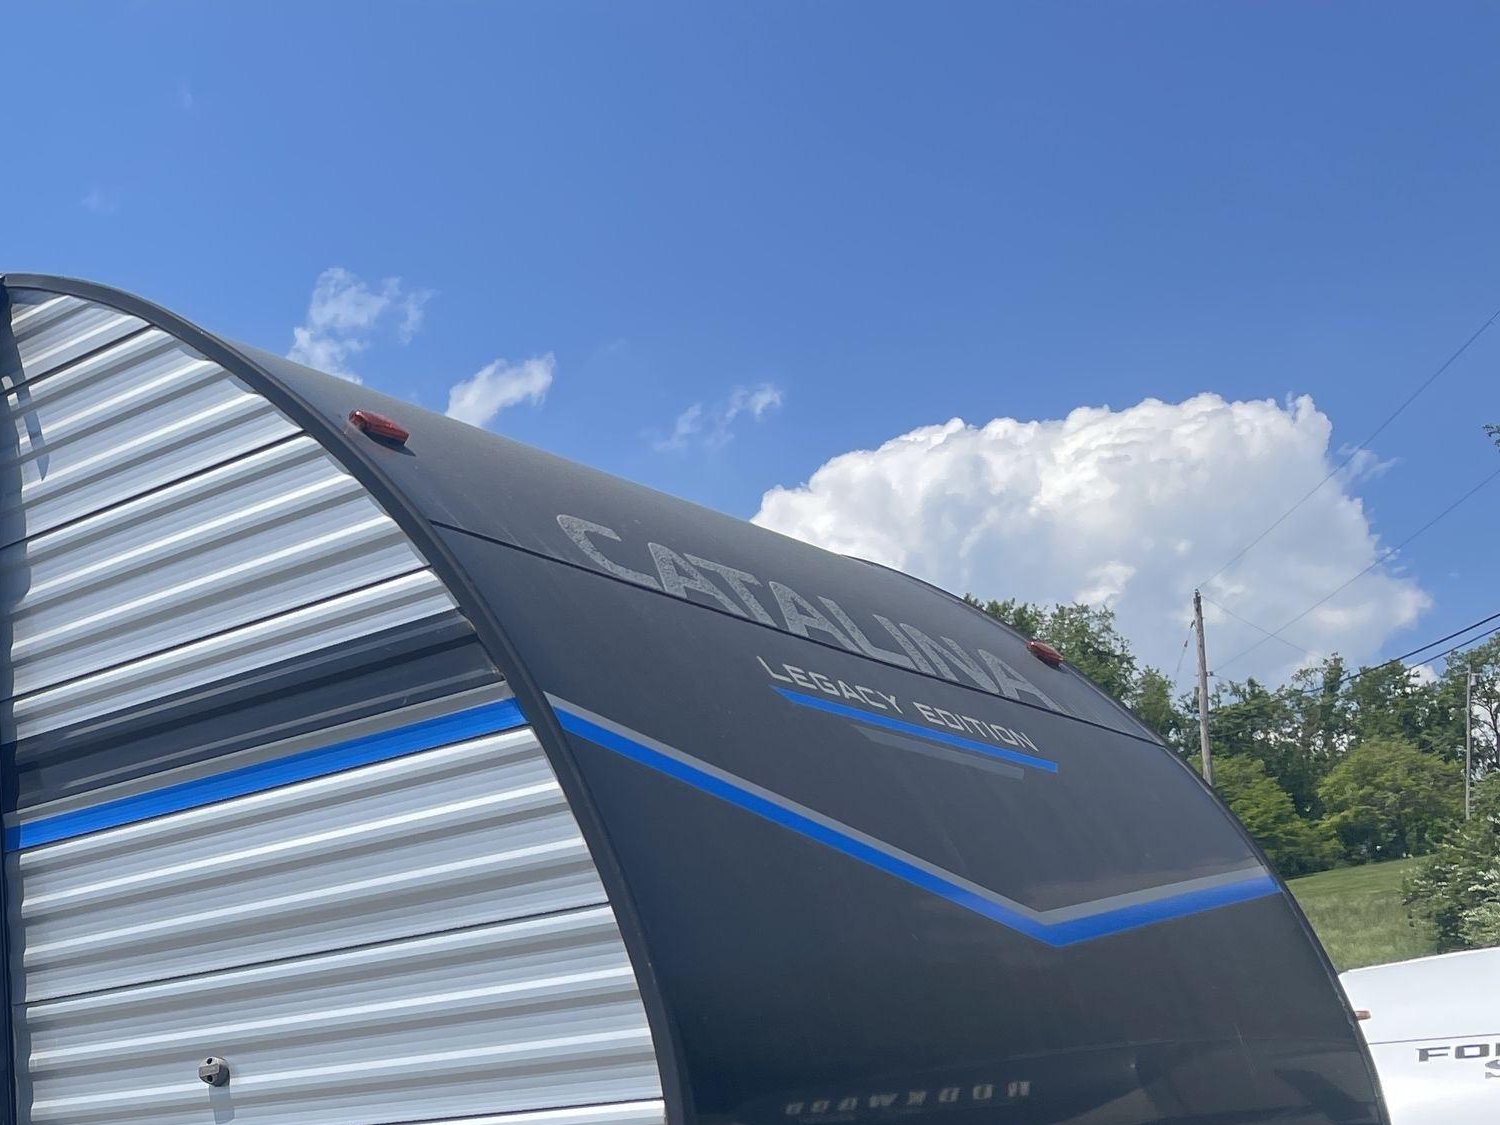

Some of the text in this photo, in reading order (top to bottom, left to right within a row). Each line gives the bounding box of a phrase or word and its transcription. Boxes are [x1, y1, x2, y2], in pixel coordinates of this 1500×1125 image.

[556, 513, 1067, 713] CATALINA
[756, 655, 1040, 752] LEGACY EDITION
